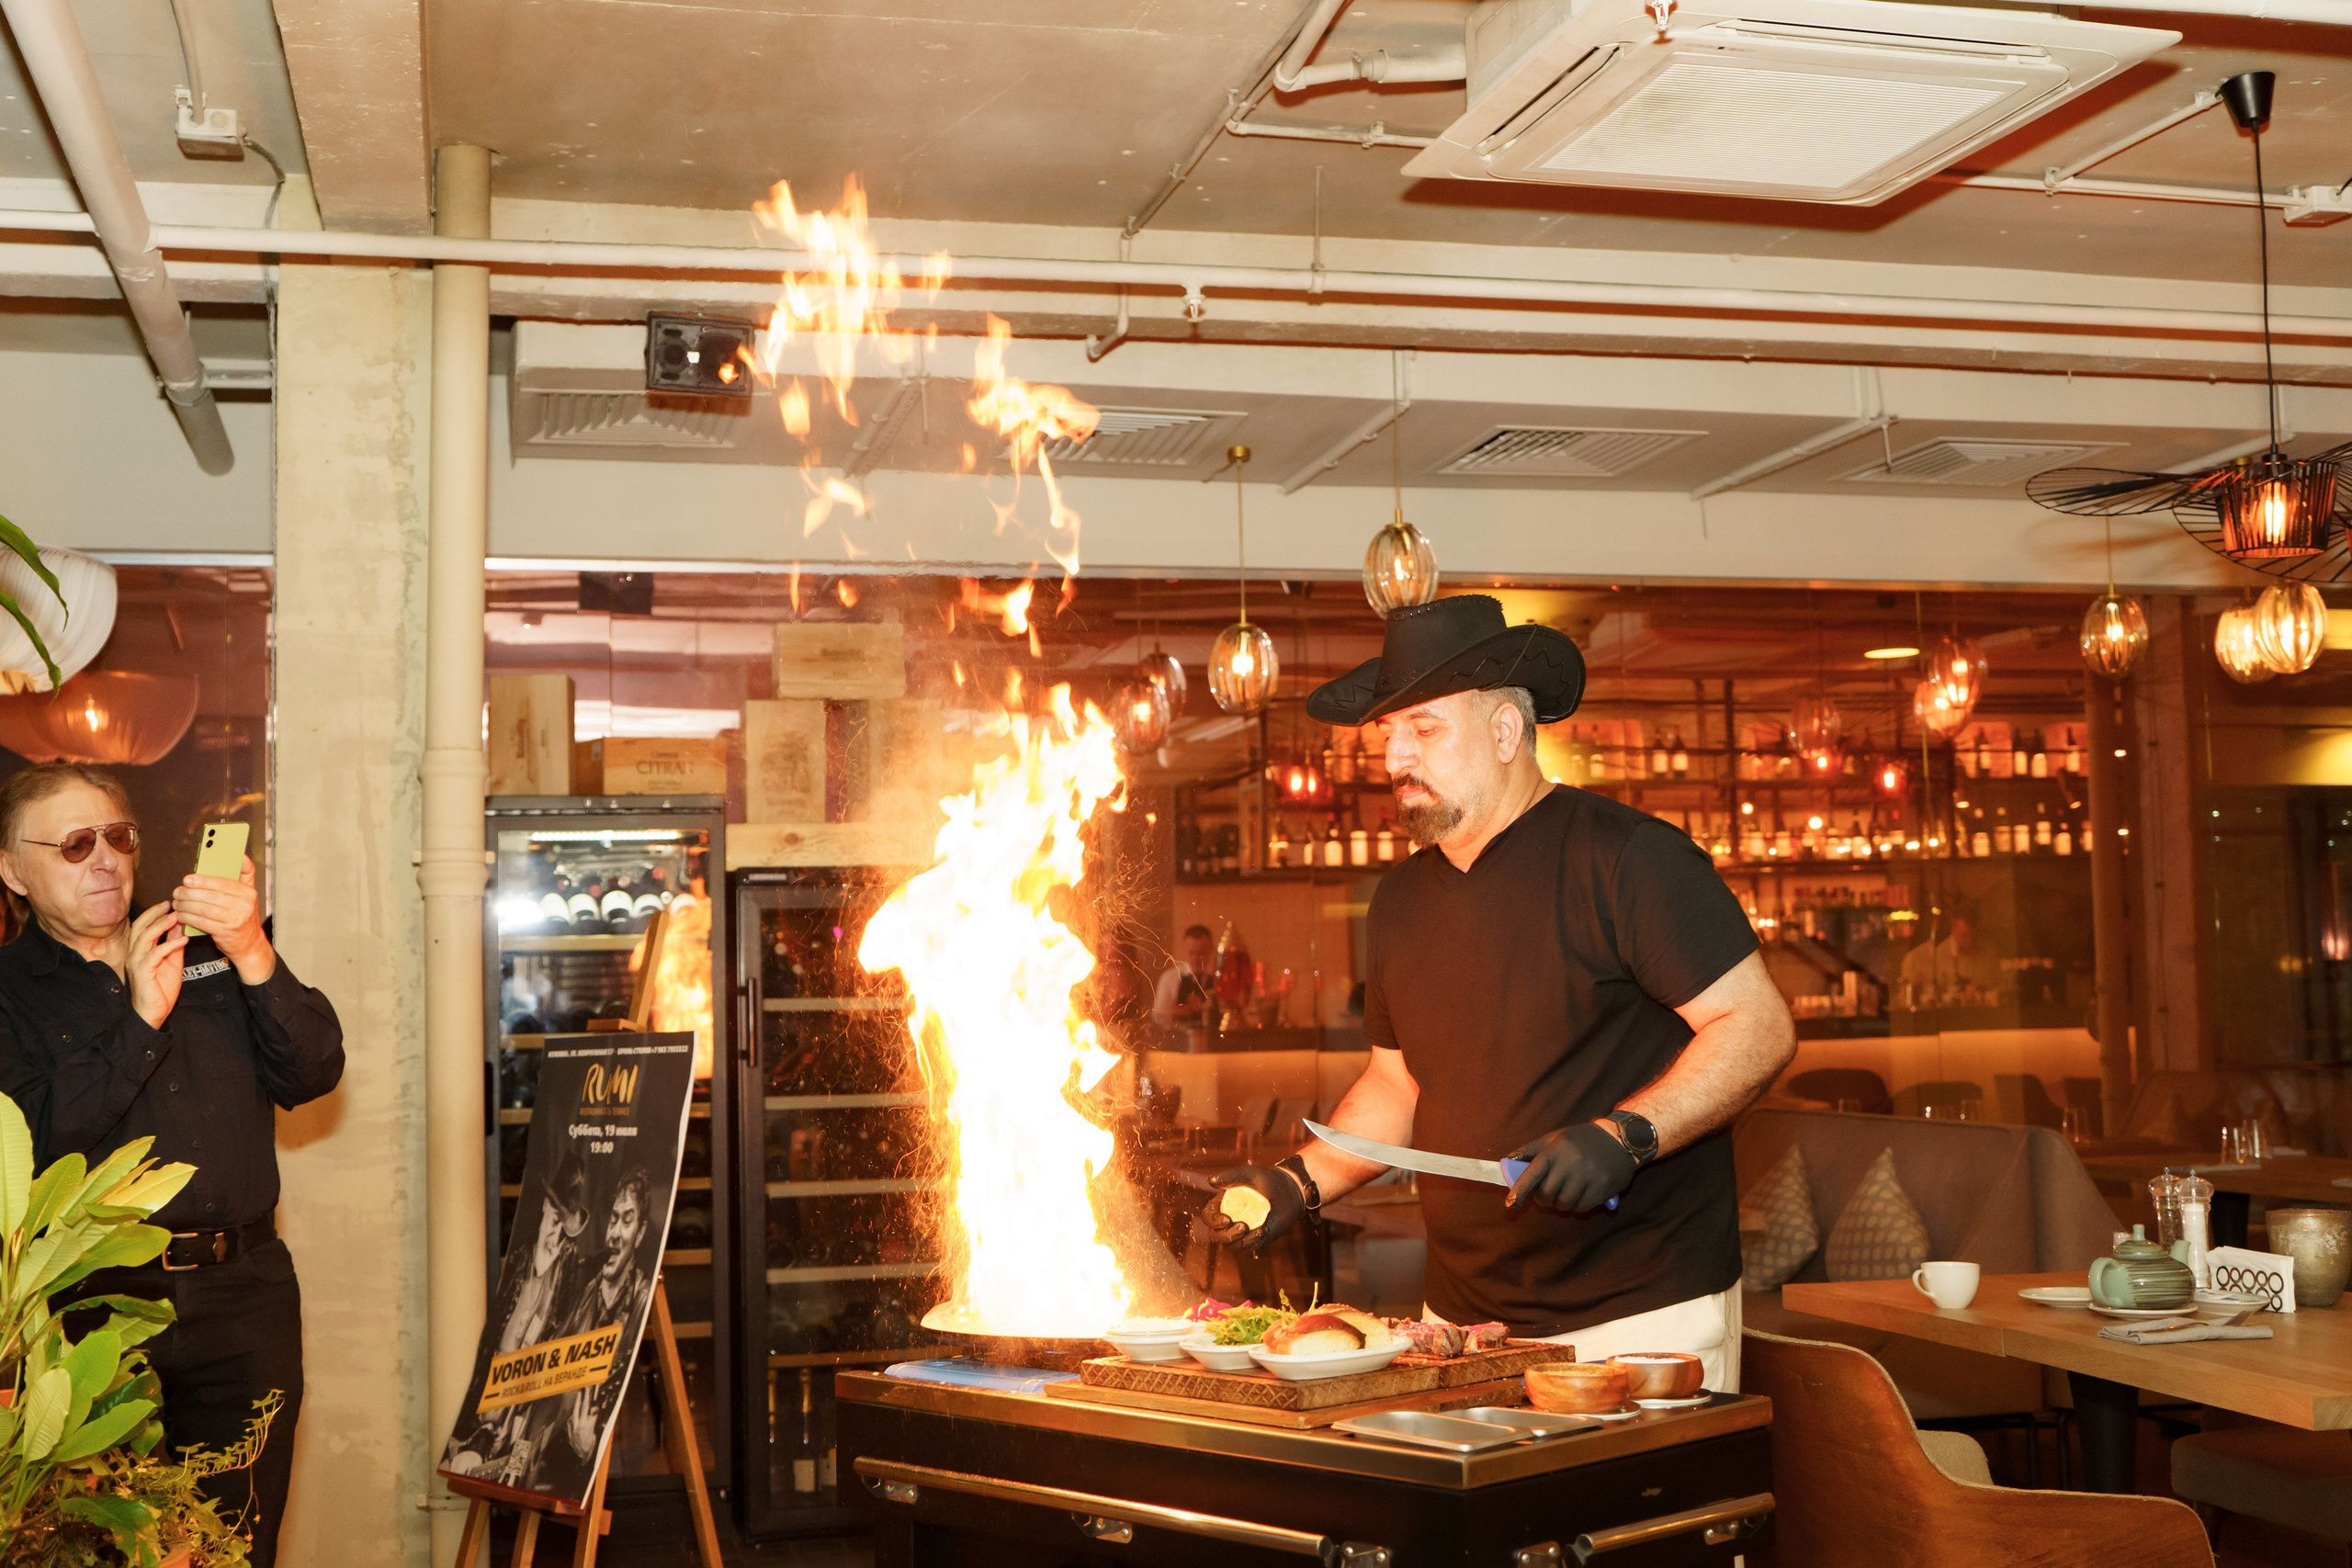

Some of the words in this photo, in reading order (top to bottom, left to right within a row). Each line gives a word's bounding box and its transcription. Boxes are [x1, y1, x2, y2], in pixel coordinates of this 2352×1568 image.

[569, 1123, 604, 1139] Суббота,
[605, 1124, 616, 1136] 19
[590, 1141, 614, 1154] 19:00
[492, 1351, 547, 1385] VORON
[548, 1348, 561, 1369] &
[564, 1334, 616, 1365] NASH
